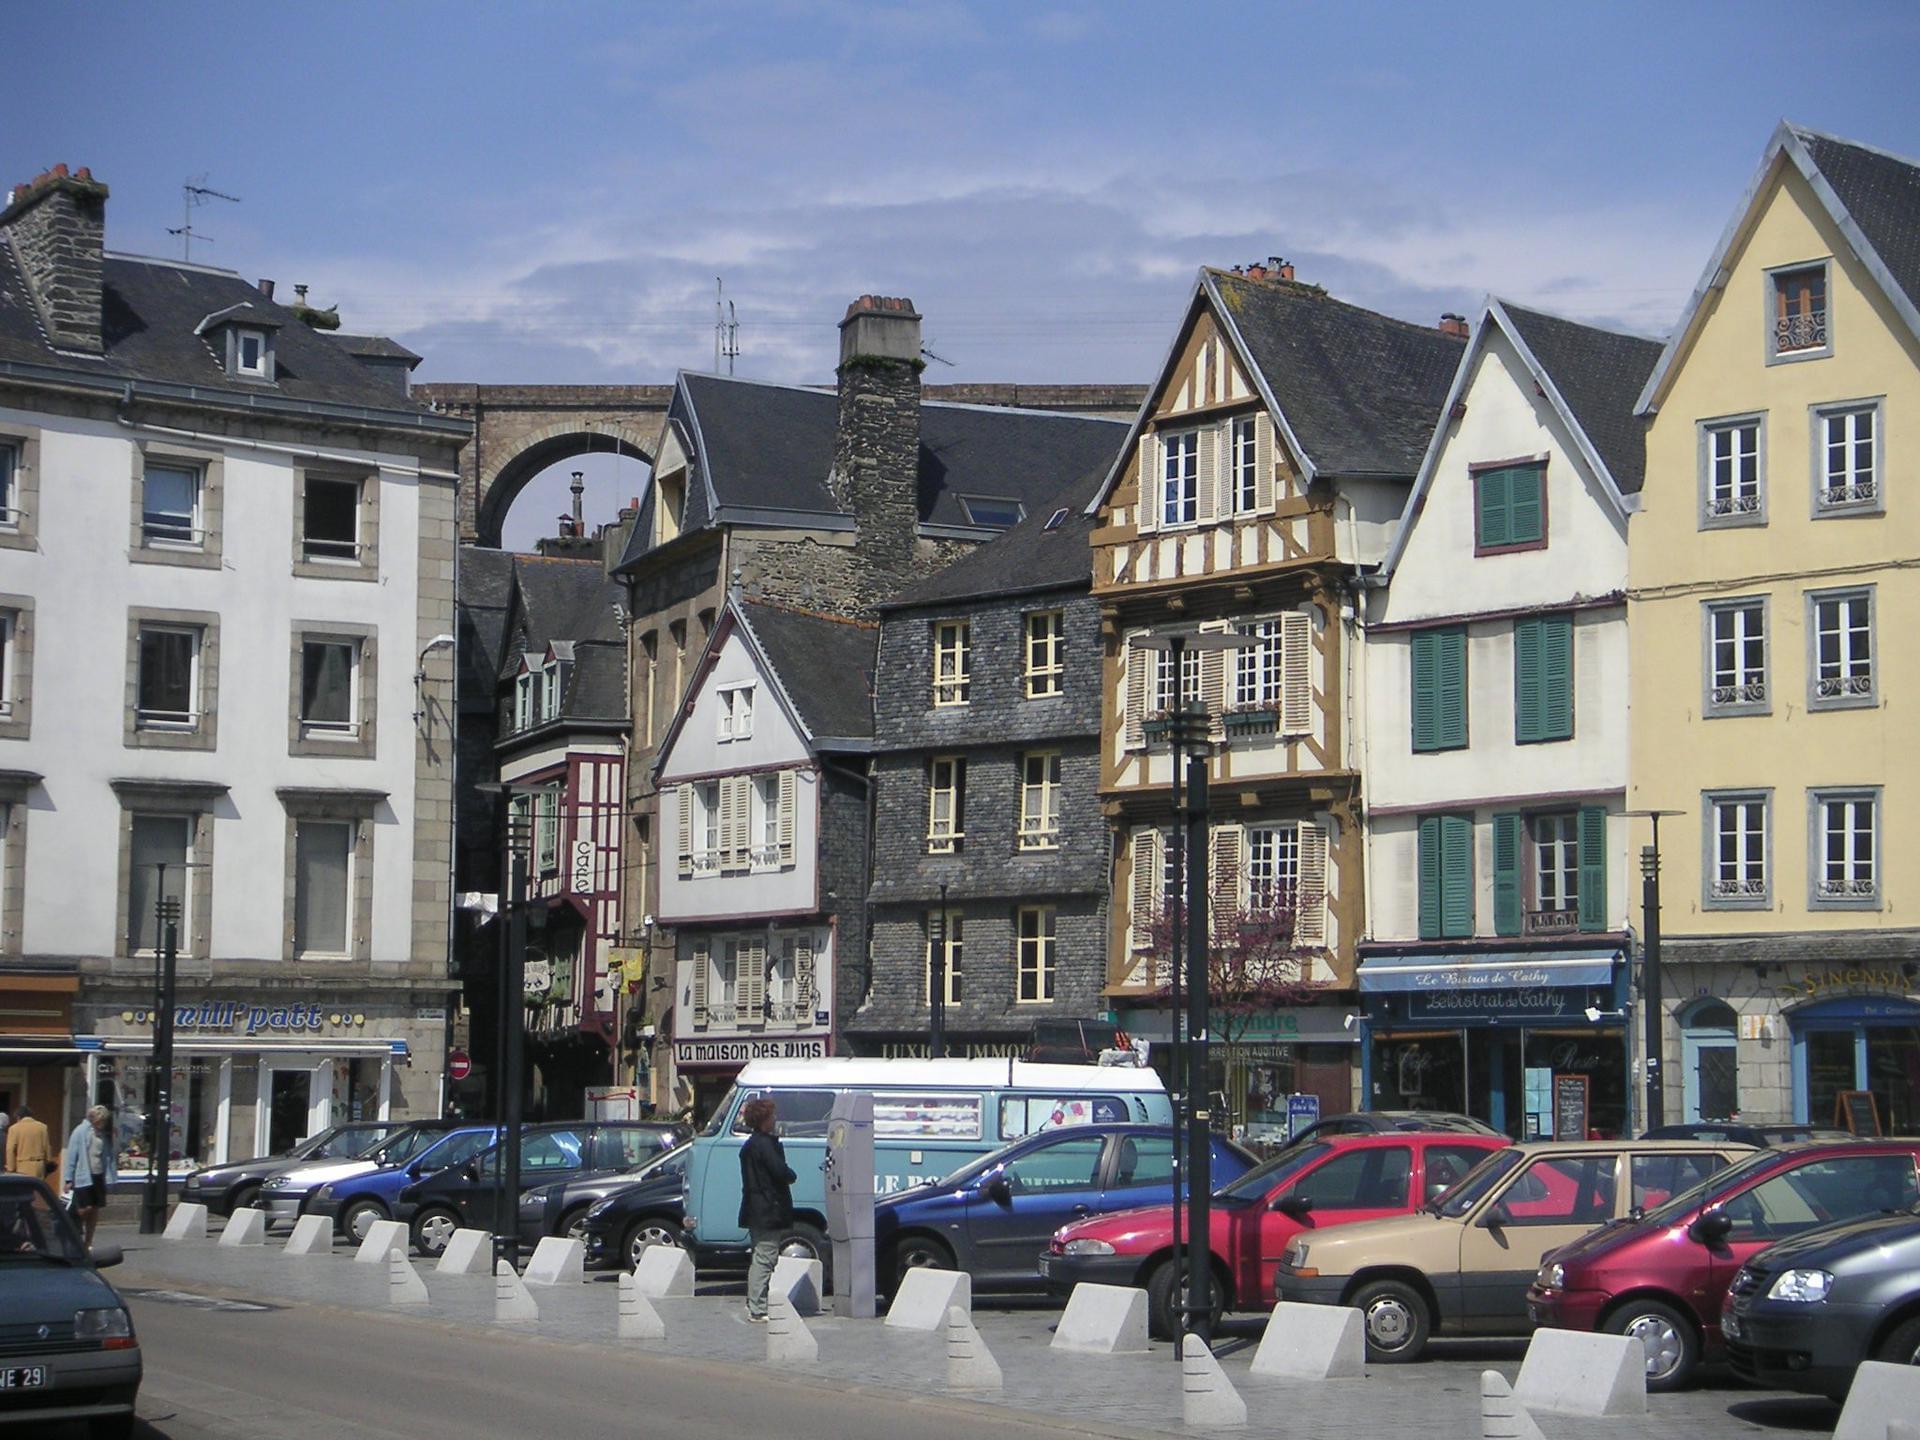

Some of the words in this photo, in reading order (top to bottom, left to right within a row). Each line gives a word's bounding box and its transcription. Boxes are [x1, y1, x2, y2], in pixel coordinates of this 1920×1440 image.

[1415, 974, 1439, 986] Le
[1441, 972, 1489, 984] Bistrot
[1491, 972, 1506, 984] de
[1508, 969, 1550, 985] Cathy
[695, 1043, 749, 1061] maison
[751, 1041, 780, 1059] des
[784, 1041, 822, 1059] vins
[23, 1367, 41, 1386] 29
